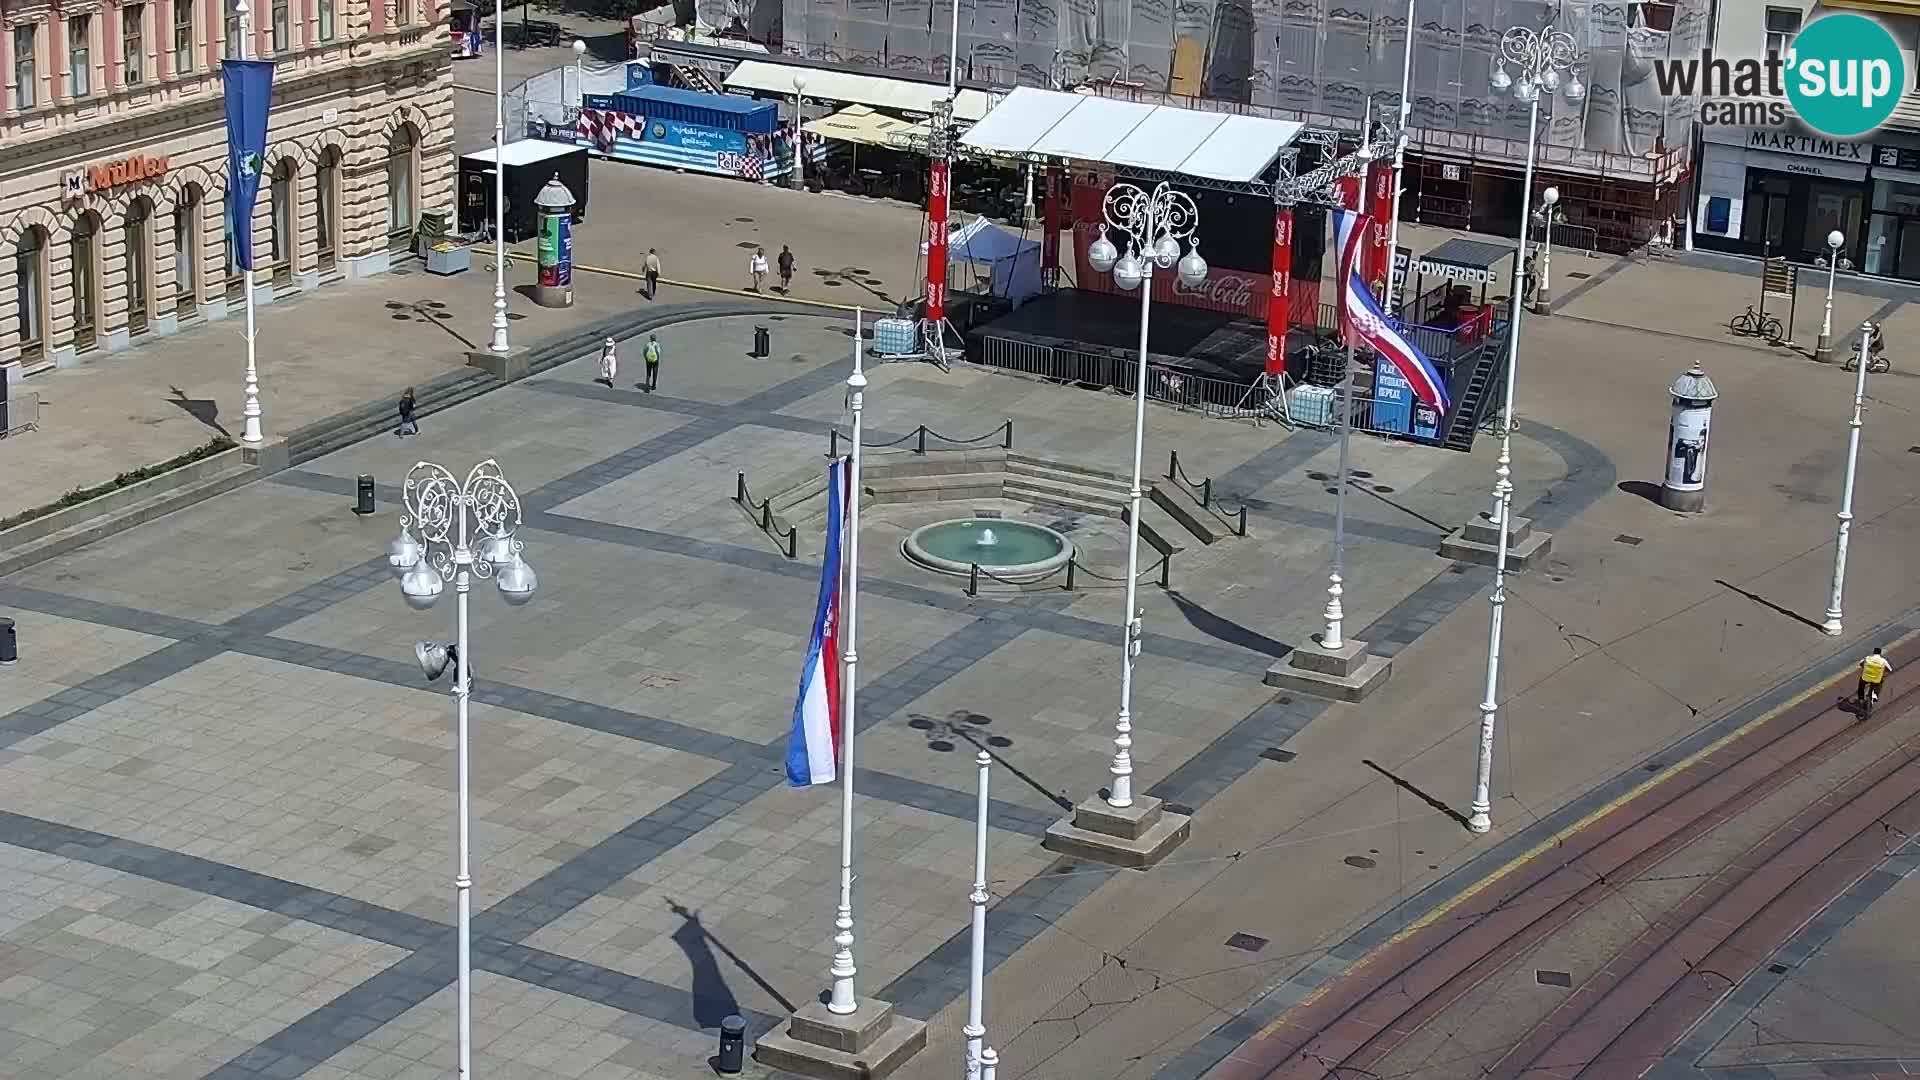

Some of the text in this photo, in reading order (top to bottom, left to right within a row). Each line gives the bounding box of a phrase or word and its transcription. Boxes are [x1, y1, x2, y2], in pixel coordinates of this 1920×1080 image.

[1751, 131, 1862, 159] MARTIMEX
[90, 154, 169, 191] Müller
[1409, 260, 1497, 284] POWERADE
[1172, 275, 1257, 306] Ca-Cola
